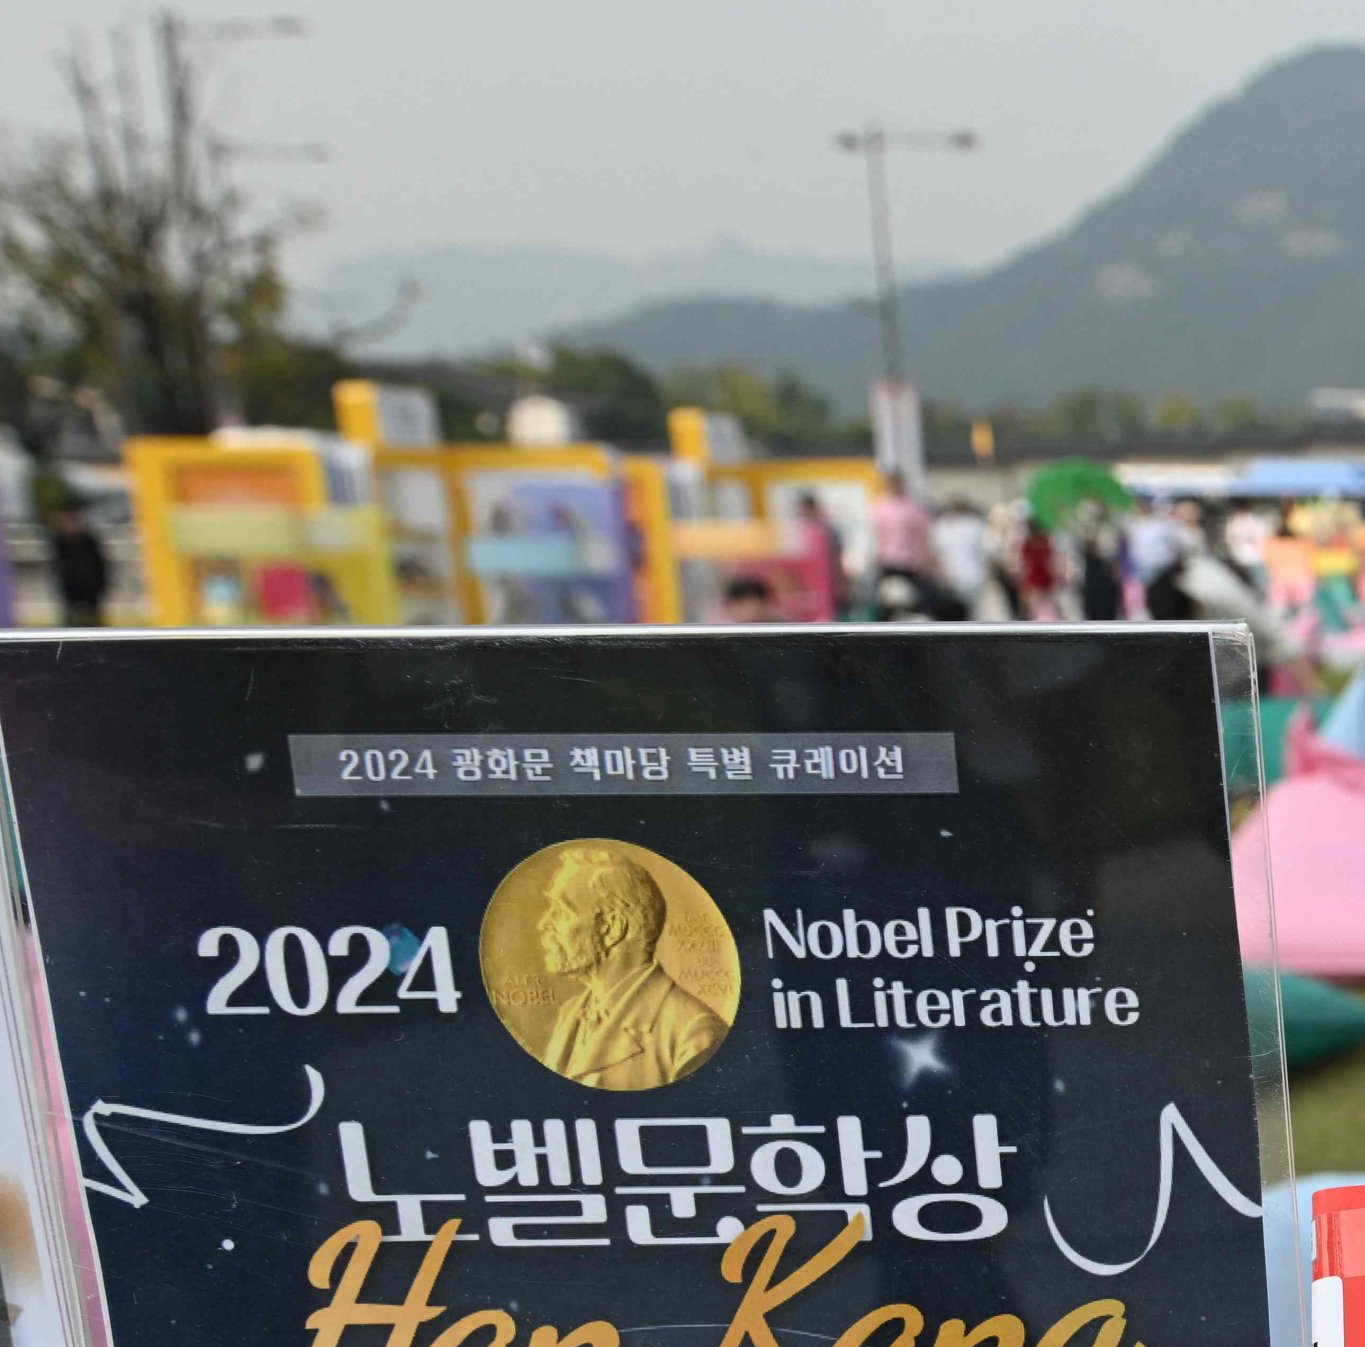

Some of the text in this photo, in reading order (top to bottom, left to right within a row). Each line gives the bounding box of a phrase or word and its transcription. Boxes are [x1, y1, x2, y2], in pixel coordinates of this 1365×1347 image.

[339, 746, 903, 781] 2024 광화문 책마당 특별 큐레이션
[763, 906, 1094, 959] Nobel Prize
[198, 926, 461, 1016] 2024
[772, 977, 1139, 1028] in Literature
[338, 1112, 1018, 1247] 노벨문학상
